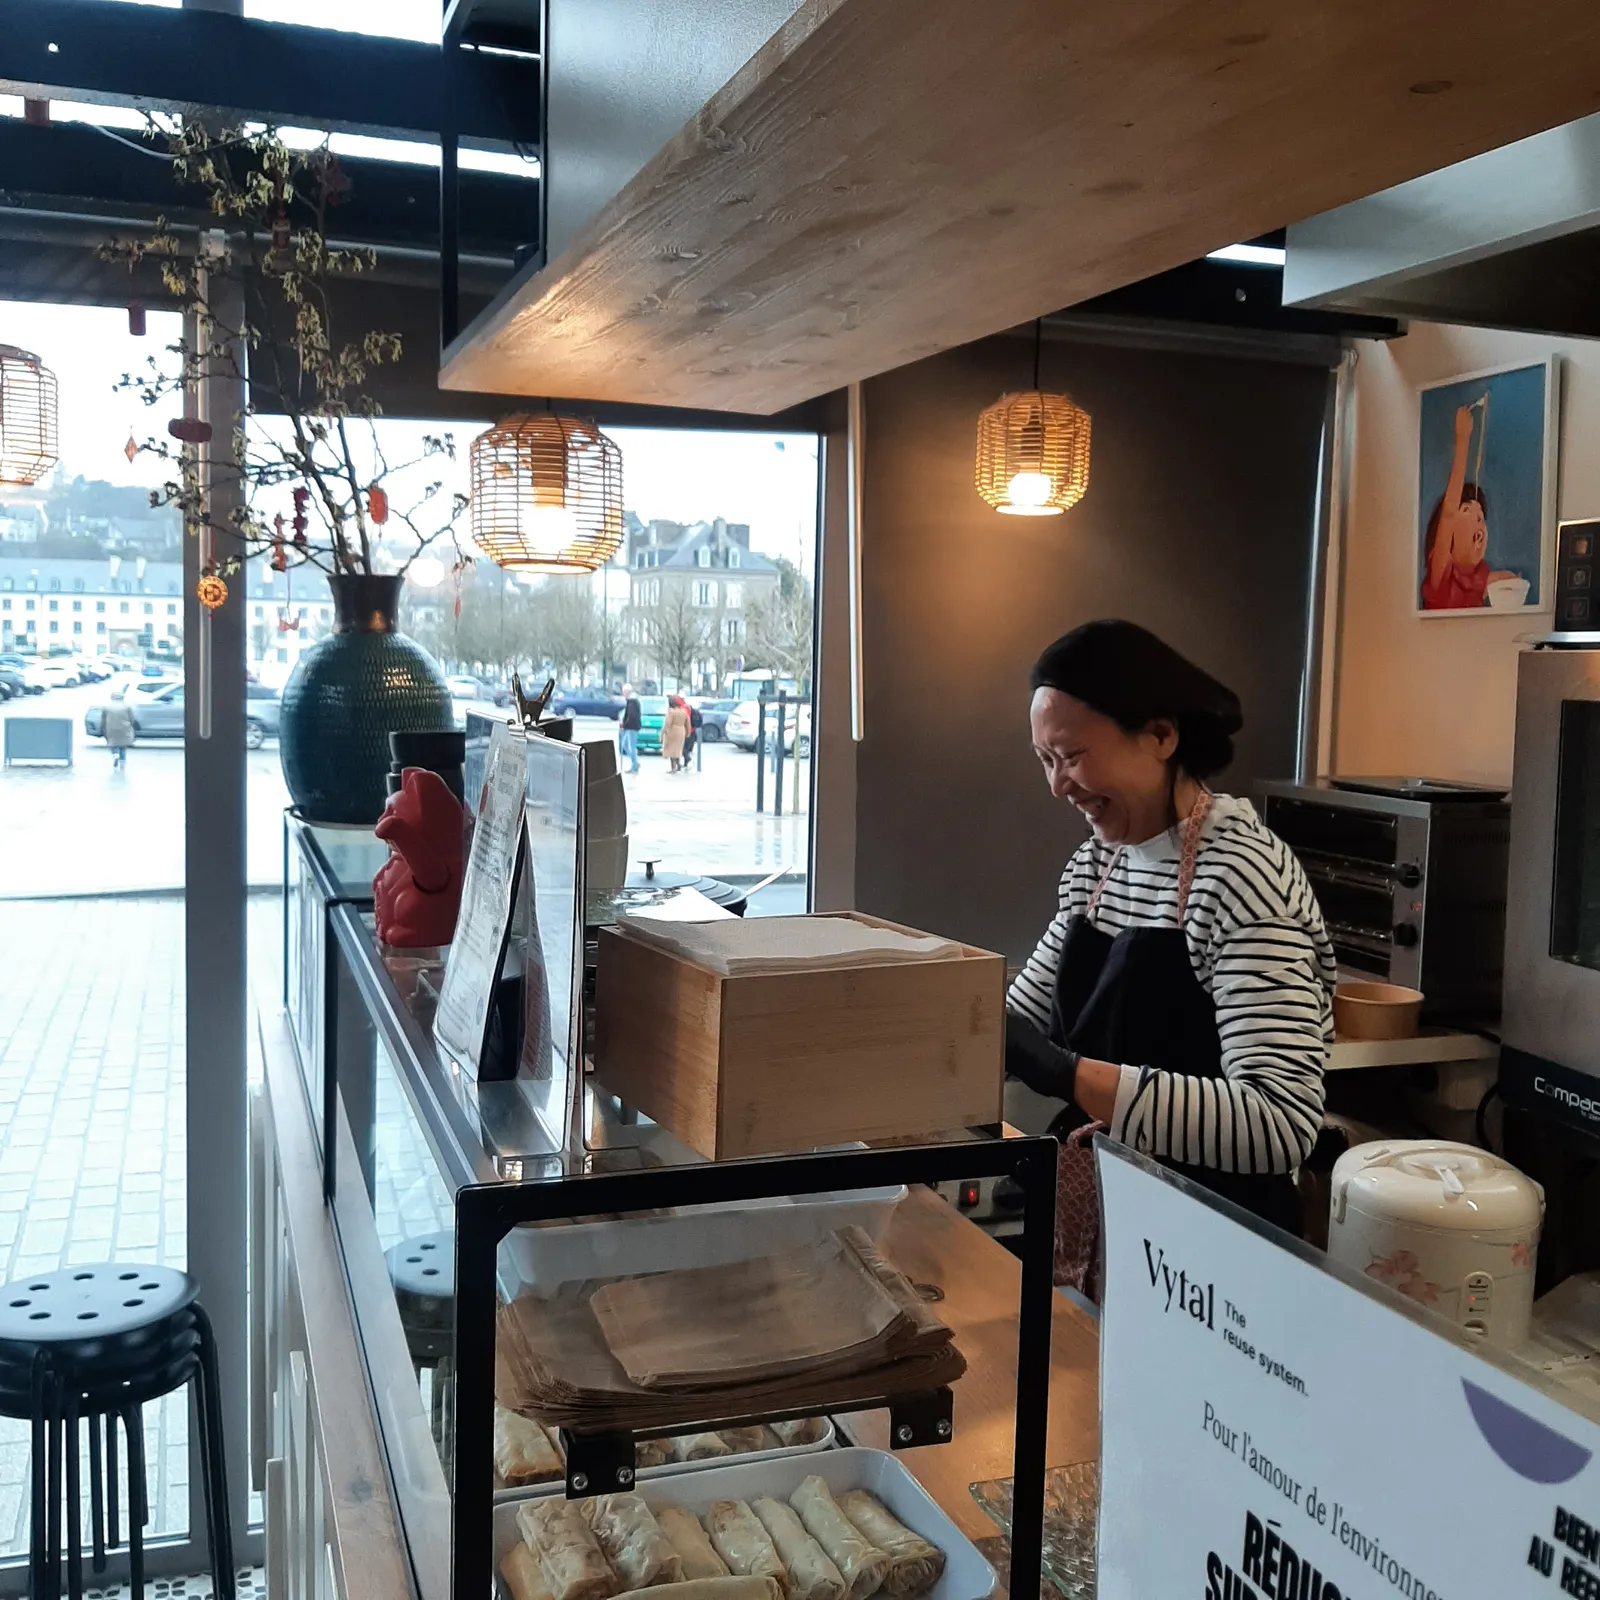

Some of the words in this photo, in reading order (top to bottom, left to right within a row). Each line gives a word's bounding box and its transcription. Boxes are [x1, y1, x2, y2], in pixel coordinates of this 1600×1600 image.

[1143, 1237, 1215, 1332] Vytal
[1224, 1300, 1246, 1329] The
[1223, 1328, 1256, 1360] reuse
[1202, 1400, 1238, 1454] Pour
[1242, 1431, 1302, 1505] l'amour
[1305, 1487, 1327, 1526] de
[1331, 1502, 1444, 1600] l'environn
[1242, 1509, 1352, 1600] RÉDU
[1527, 1534, 1556, 1579] AU
[1554, 1504, 1600, 1566] BIEN
